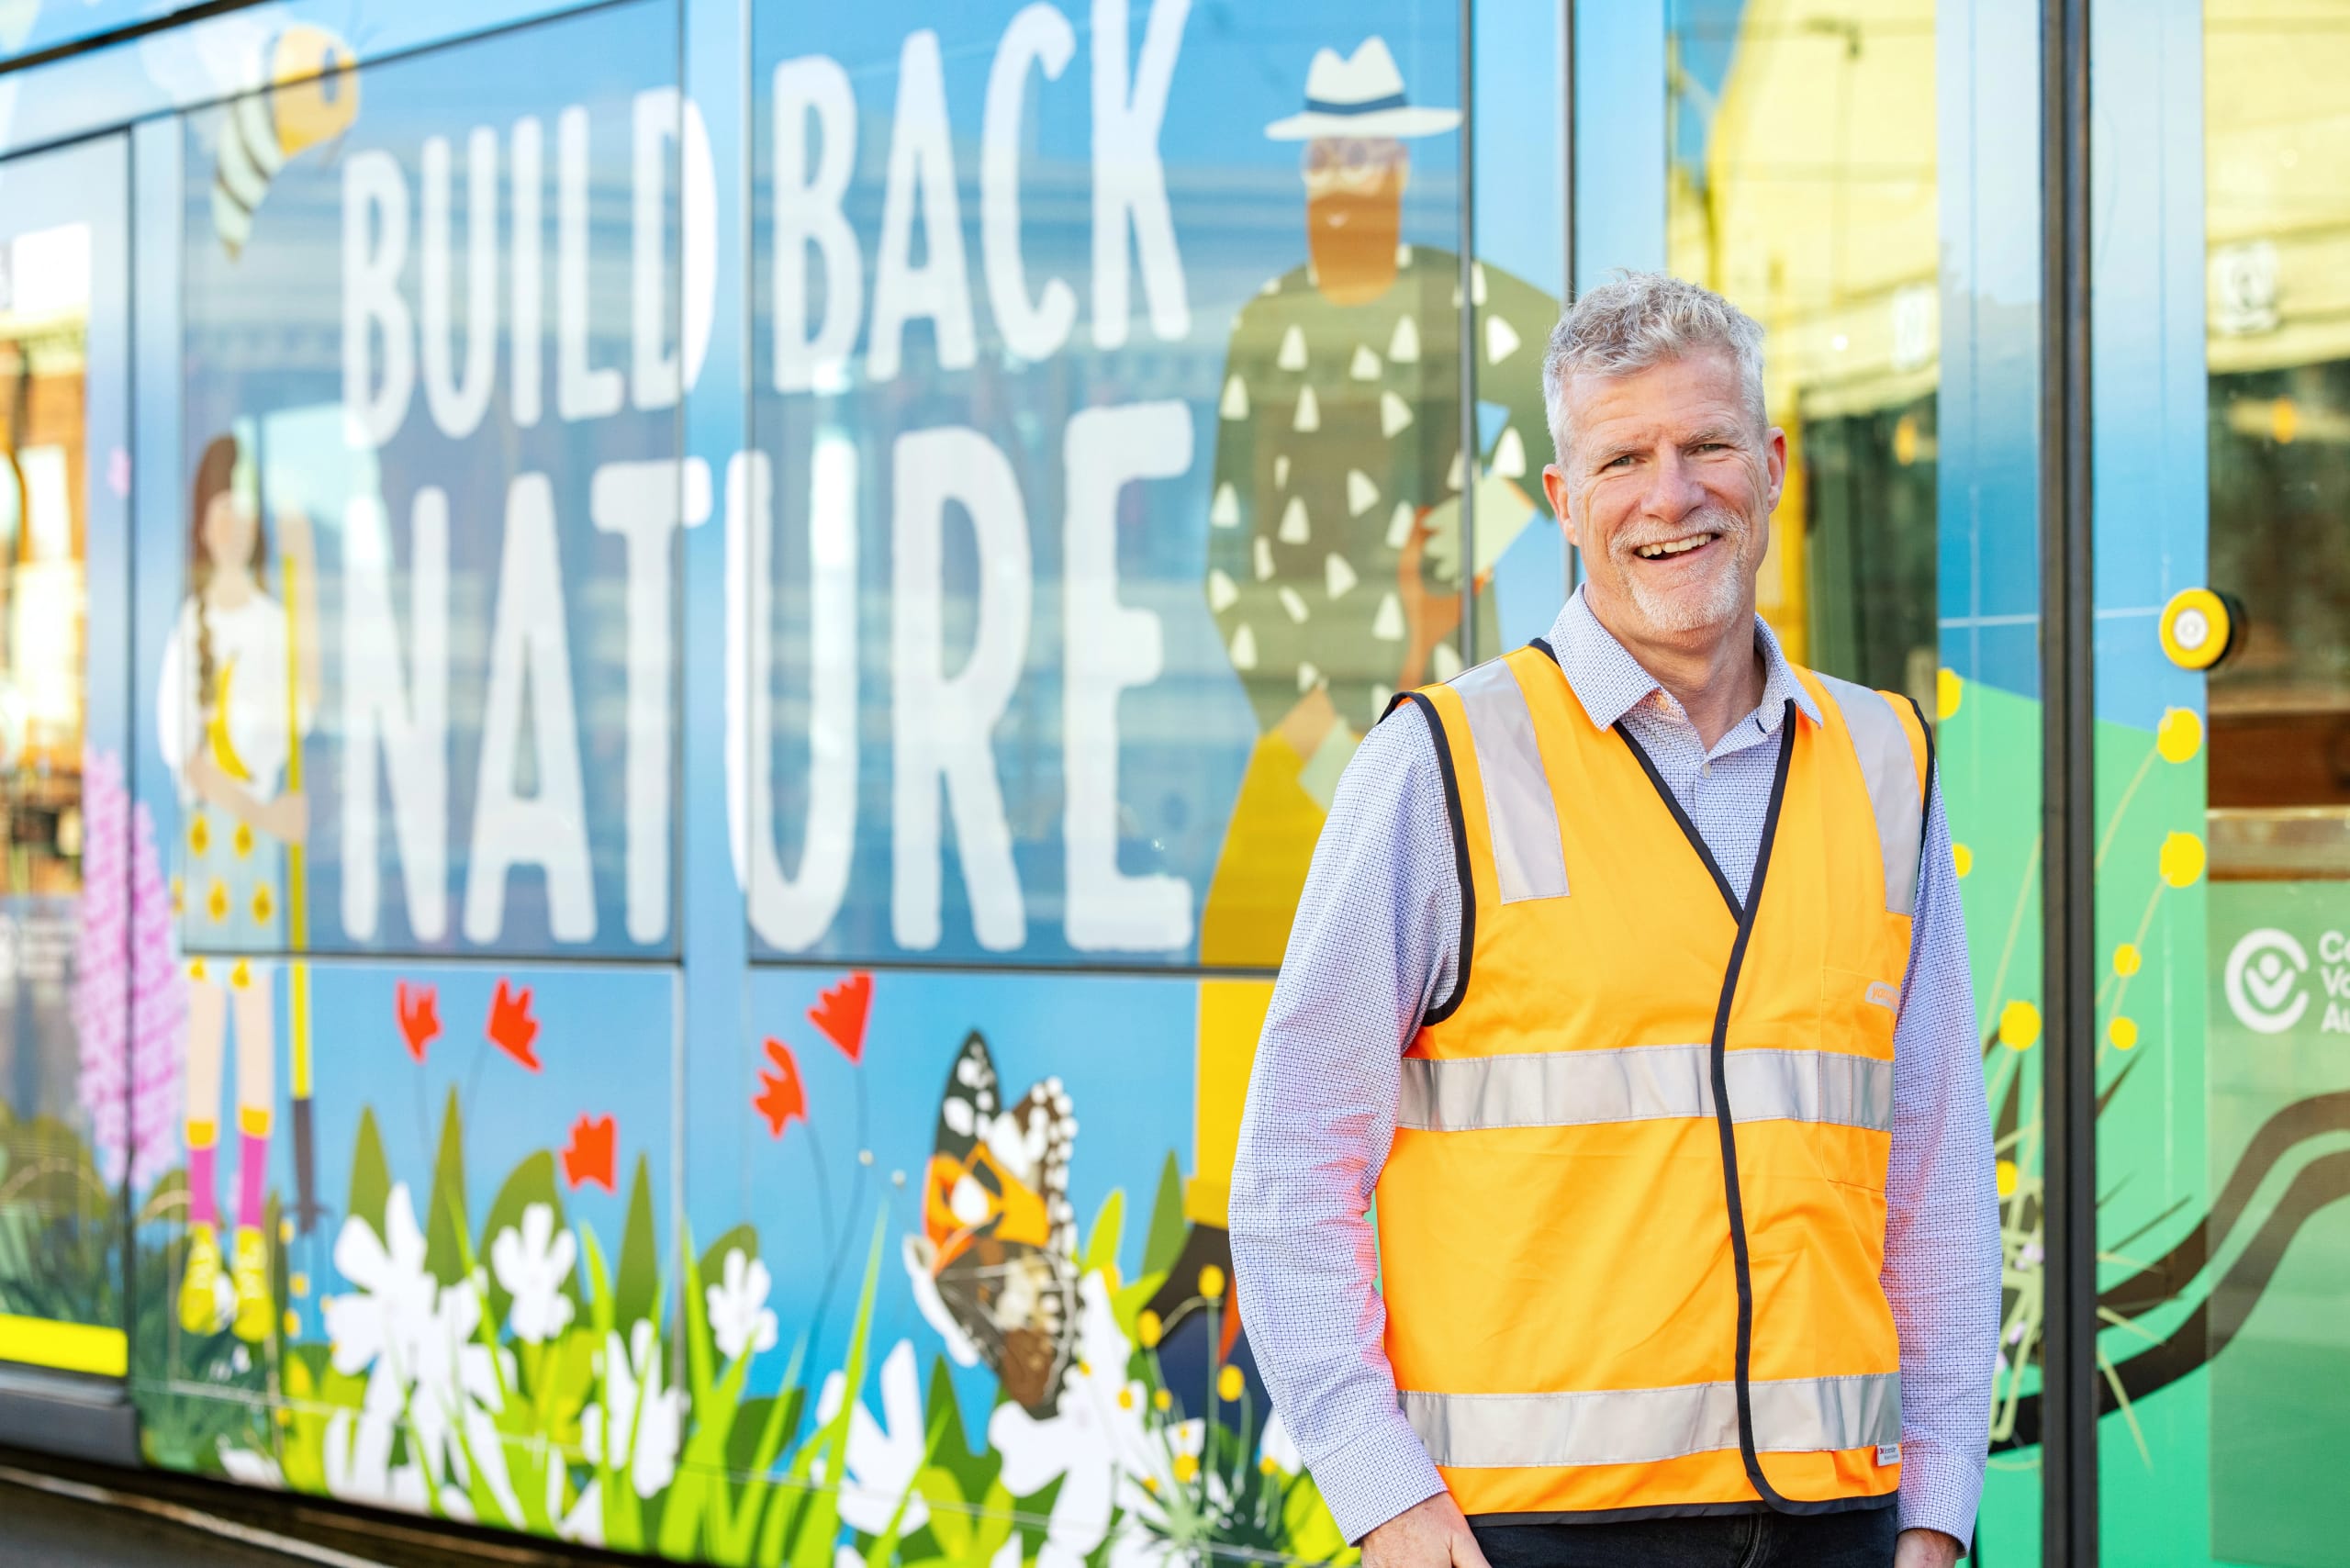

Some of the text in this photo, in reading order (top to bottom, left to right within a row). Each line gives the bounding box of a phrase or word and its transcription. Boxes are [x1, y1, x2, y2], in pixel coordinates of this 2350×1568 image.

[341, 0, 1191, 450] BUILD BACK
[341, 400, 1193, 951] NATURE
